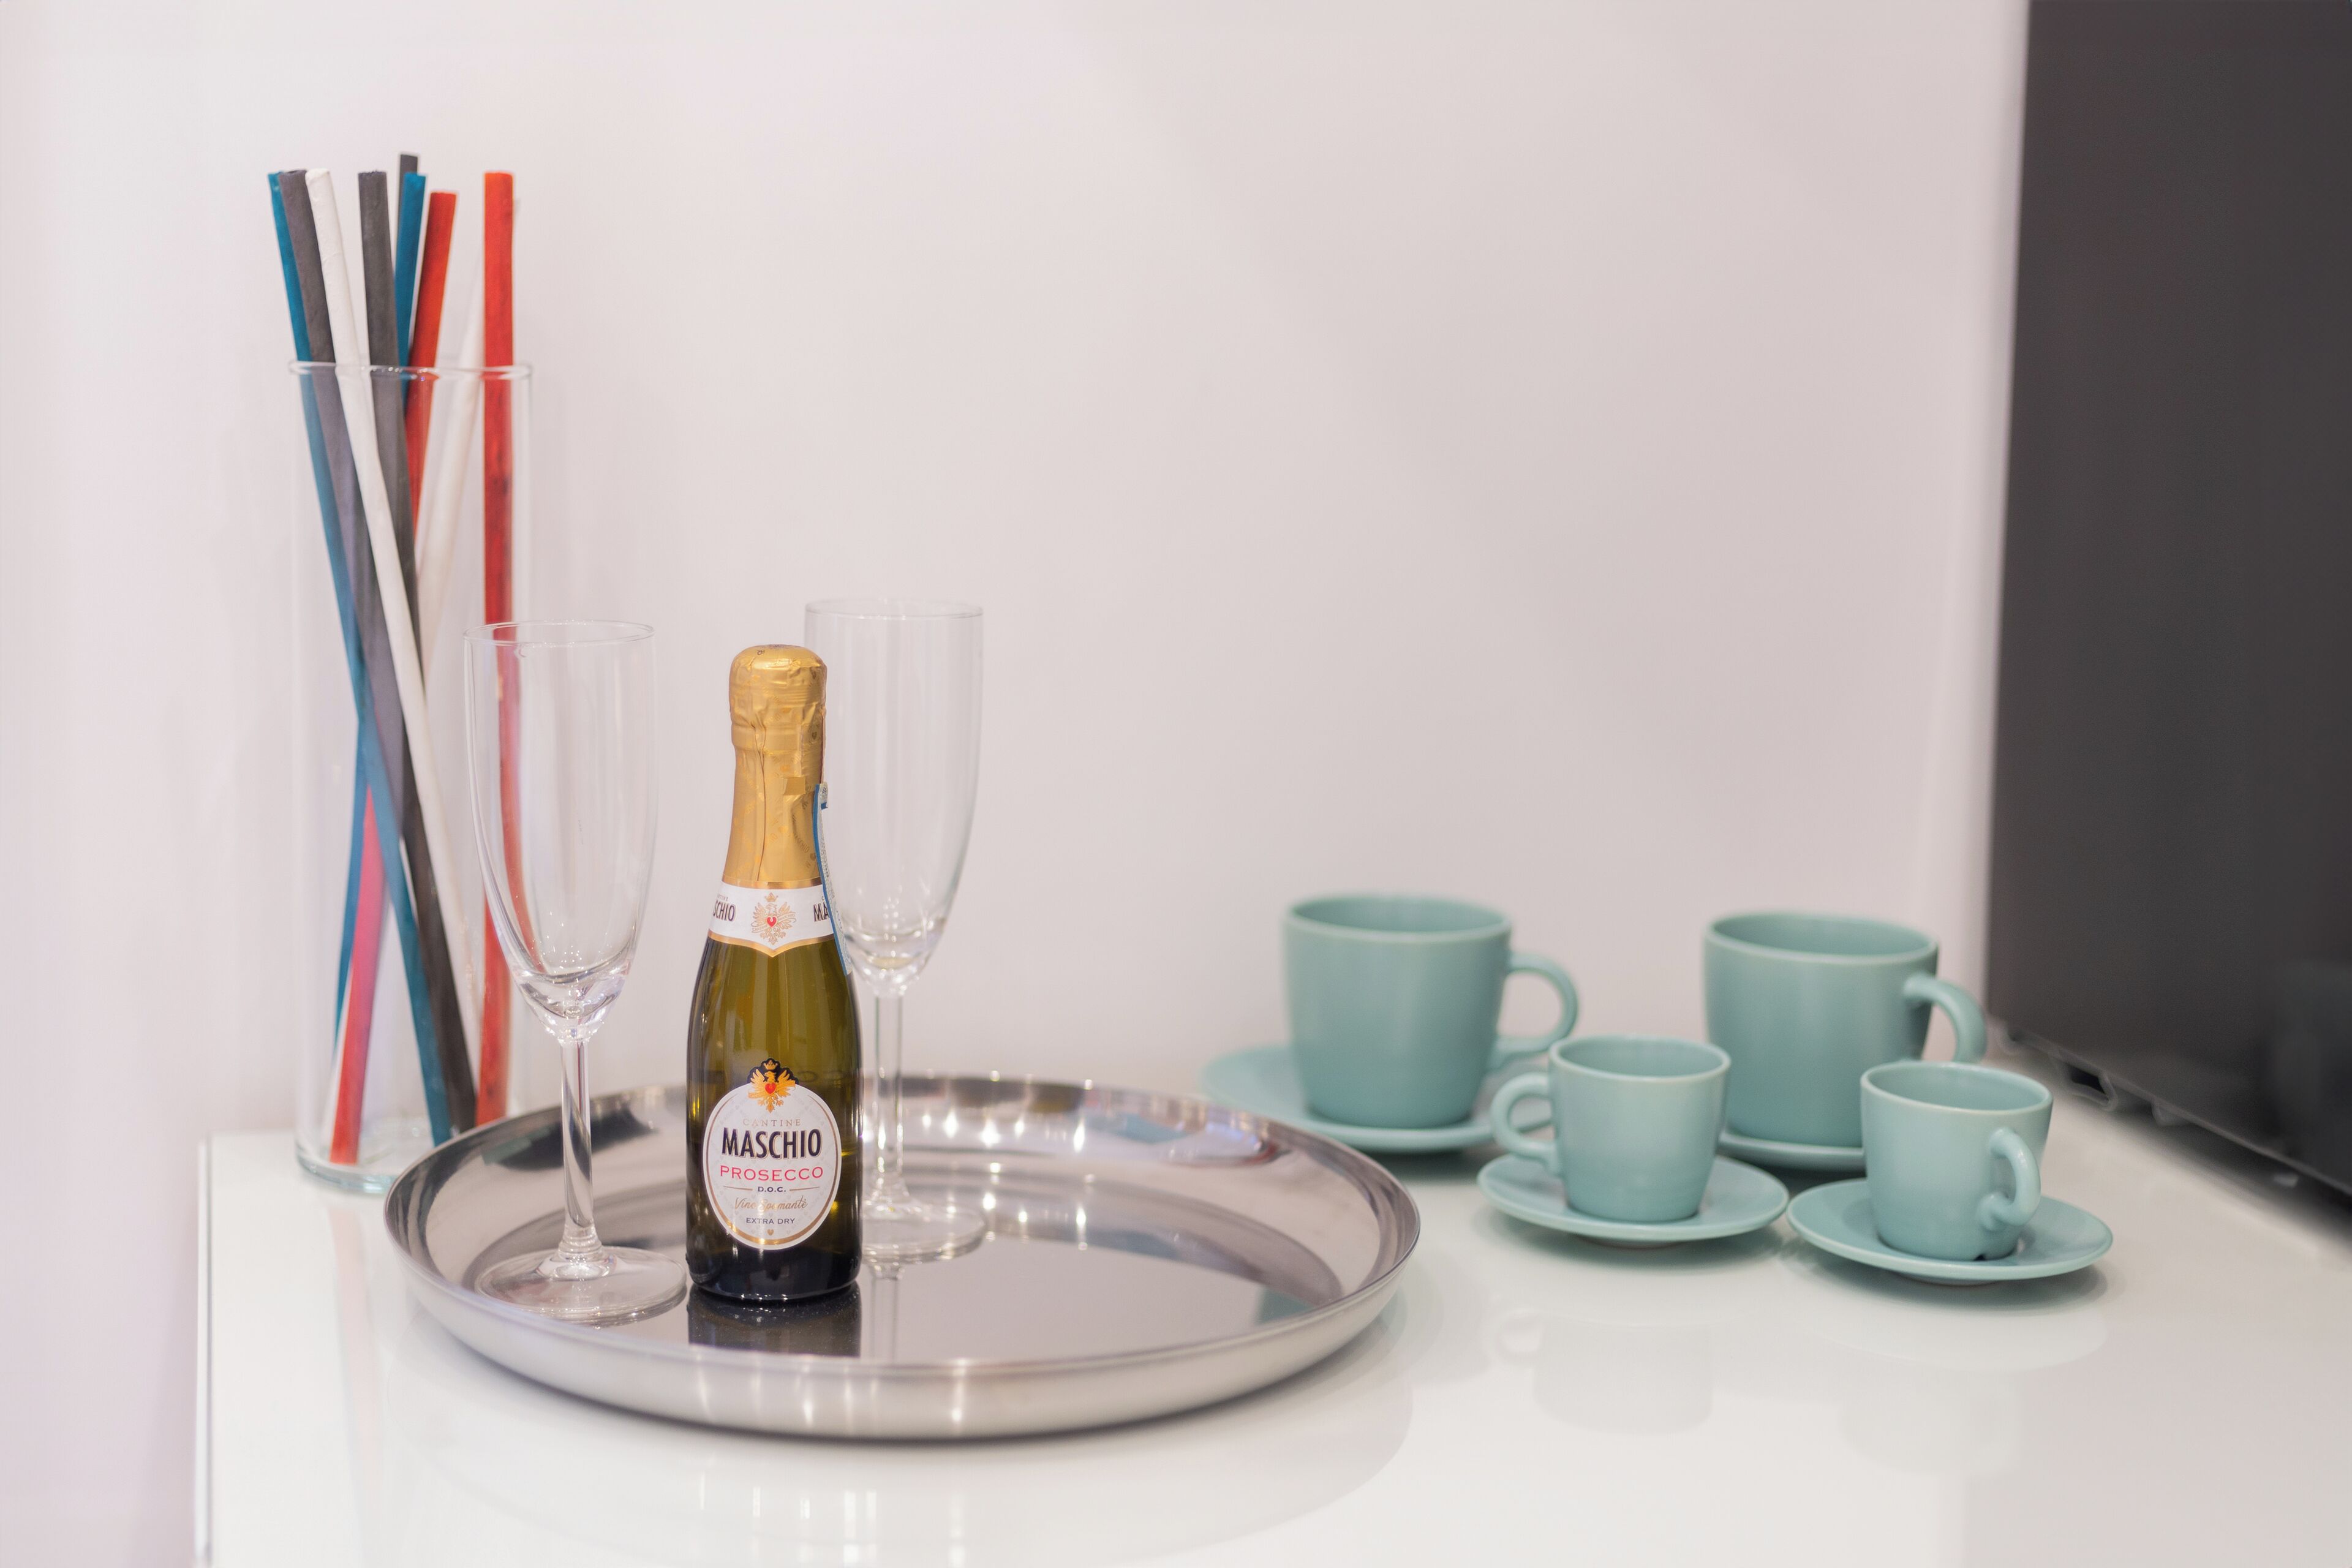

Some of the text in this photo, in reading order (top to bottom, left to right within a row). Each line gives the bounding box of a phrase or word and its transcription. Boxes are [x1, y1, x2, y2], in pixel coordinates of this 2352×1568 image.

[712, 899, 736, 922] SCHIO
[742, 1118, 801, 1127] CANTINE
[722, 1126, 823, 1160] MASCHIO
[720, 1165, 824, 1182] PROSECCO
